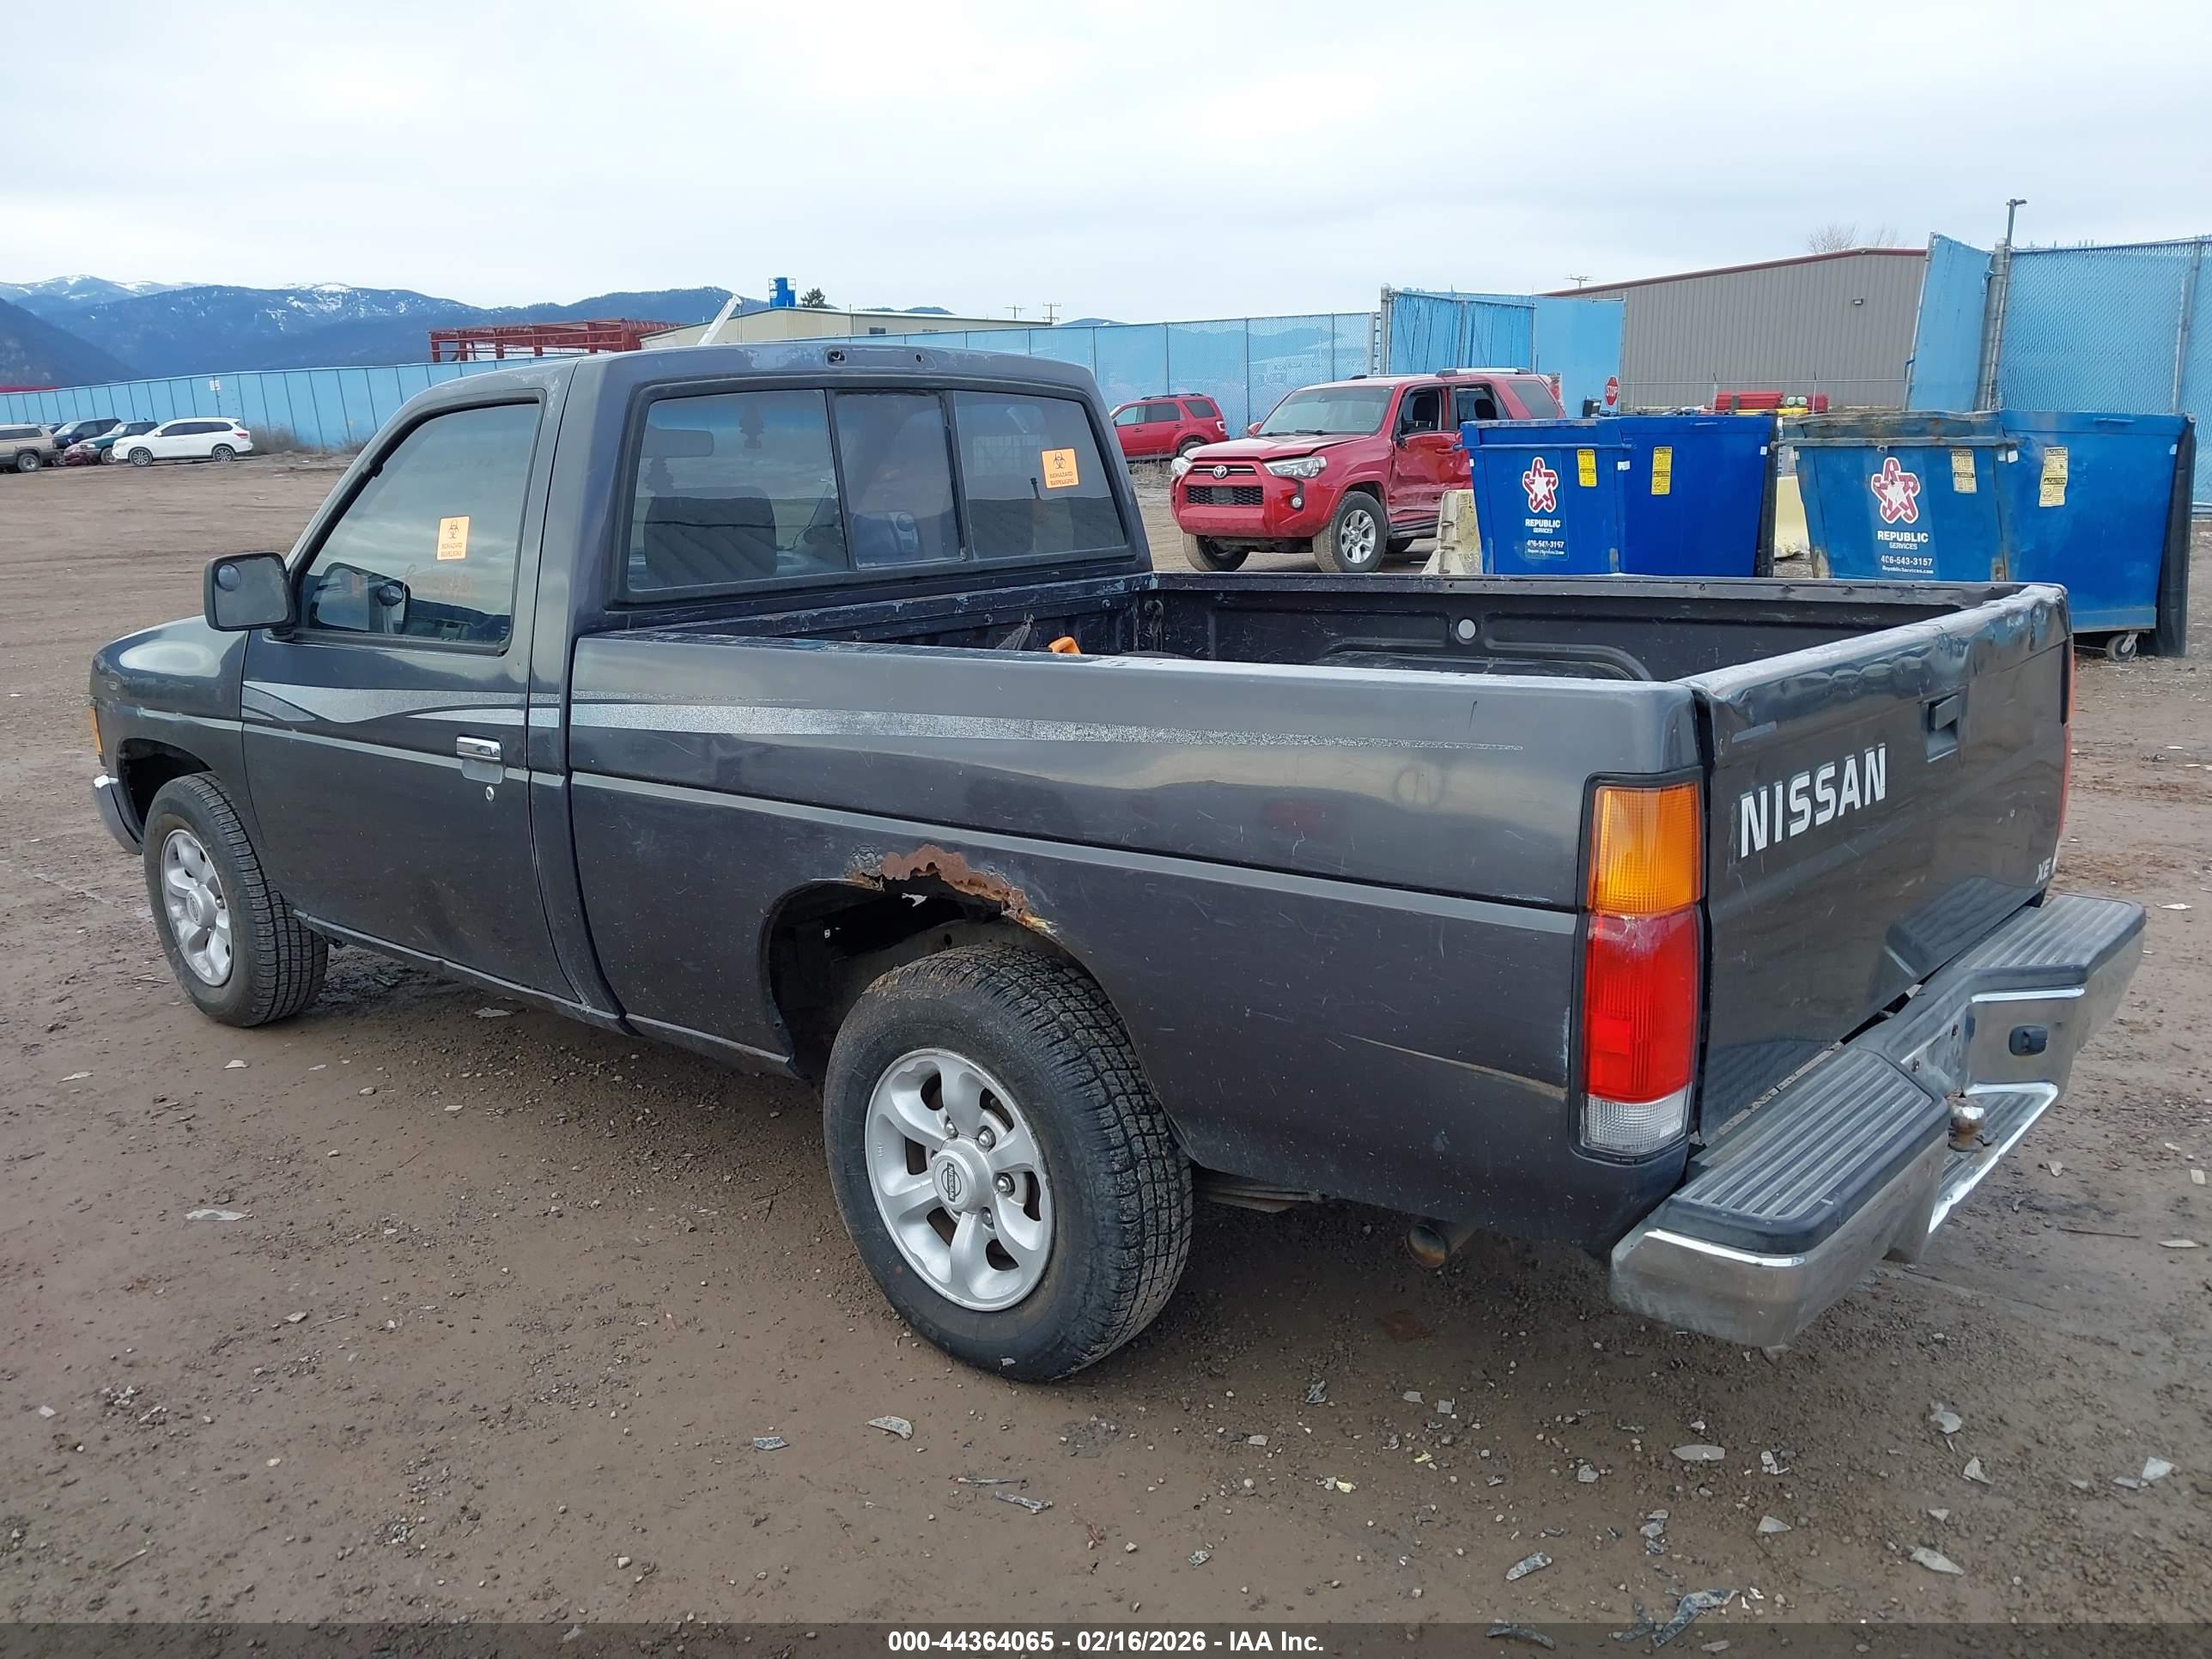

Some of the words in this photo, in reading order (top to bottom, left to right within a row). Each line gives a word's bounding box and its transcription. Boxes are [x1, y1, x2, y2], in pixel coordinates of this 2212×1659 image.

[1607, 386, 1618, 397] STOP
[1525, 519, 1560, 528] REPUBLIC
[1877, 531, 1929, 543] REPUBLIC
[1881, 555, 1933, 566] 406-543-3157
[1740, 743, 1887, 859] NISSAN
[2034, 857, 2051, 884] XE
